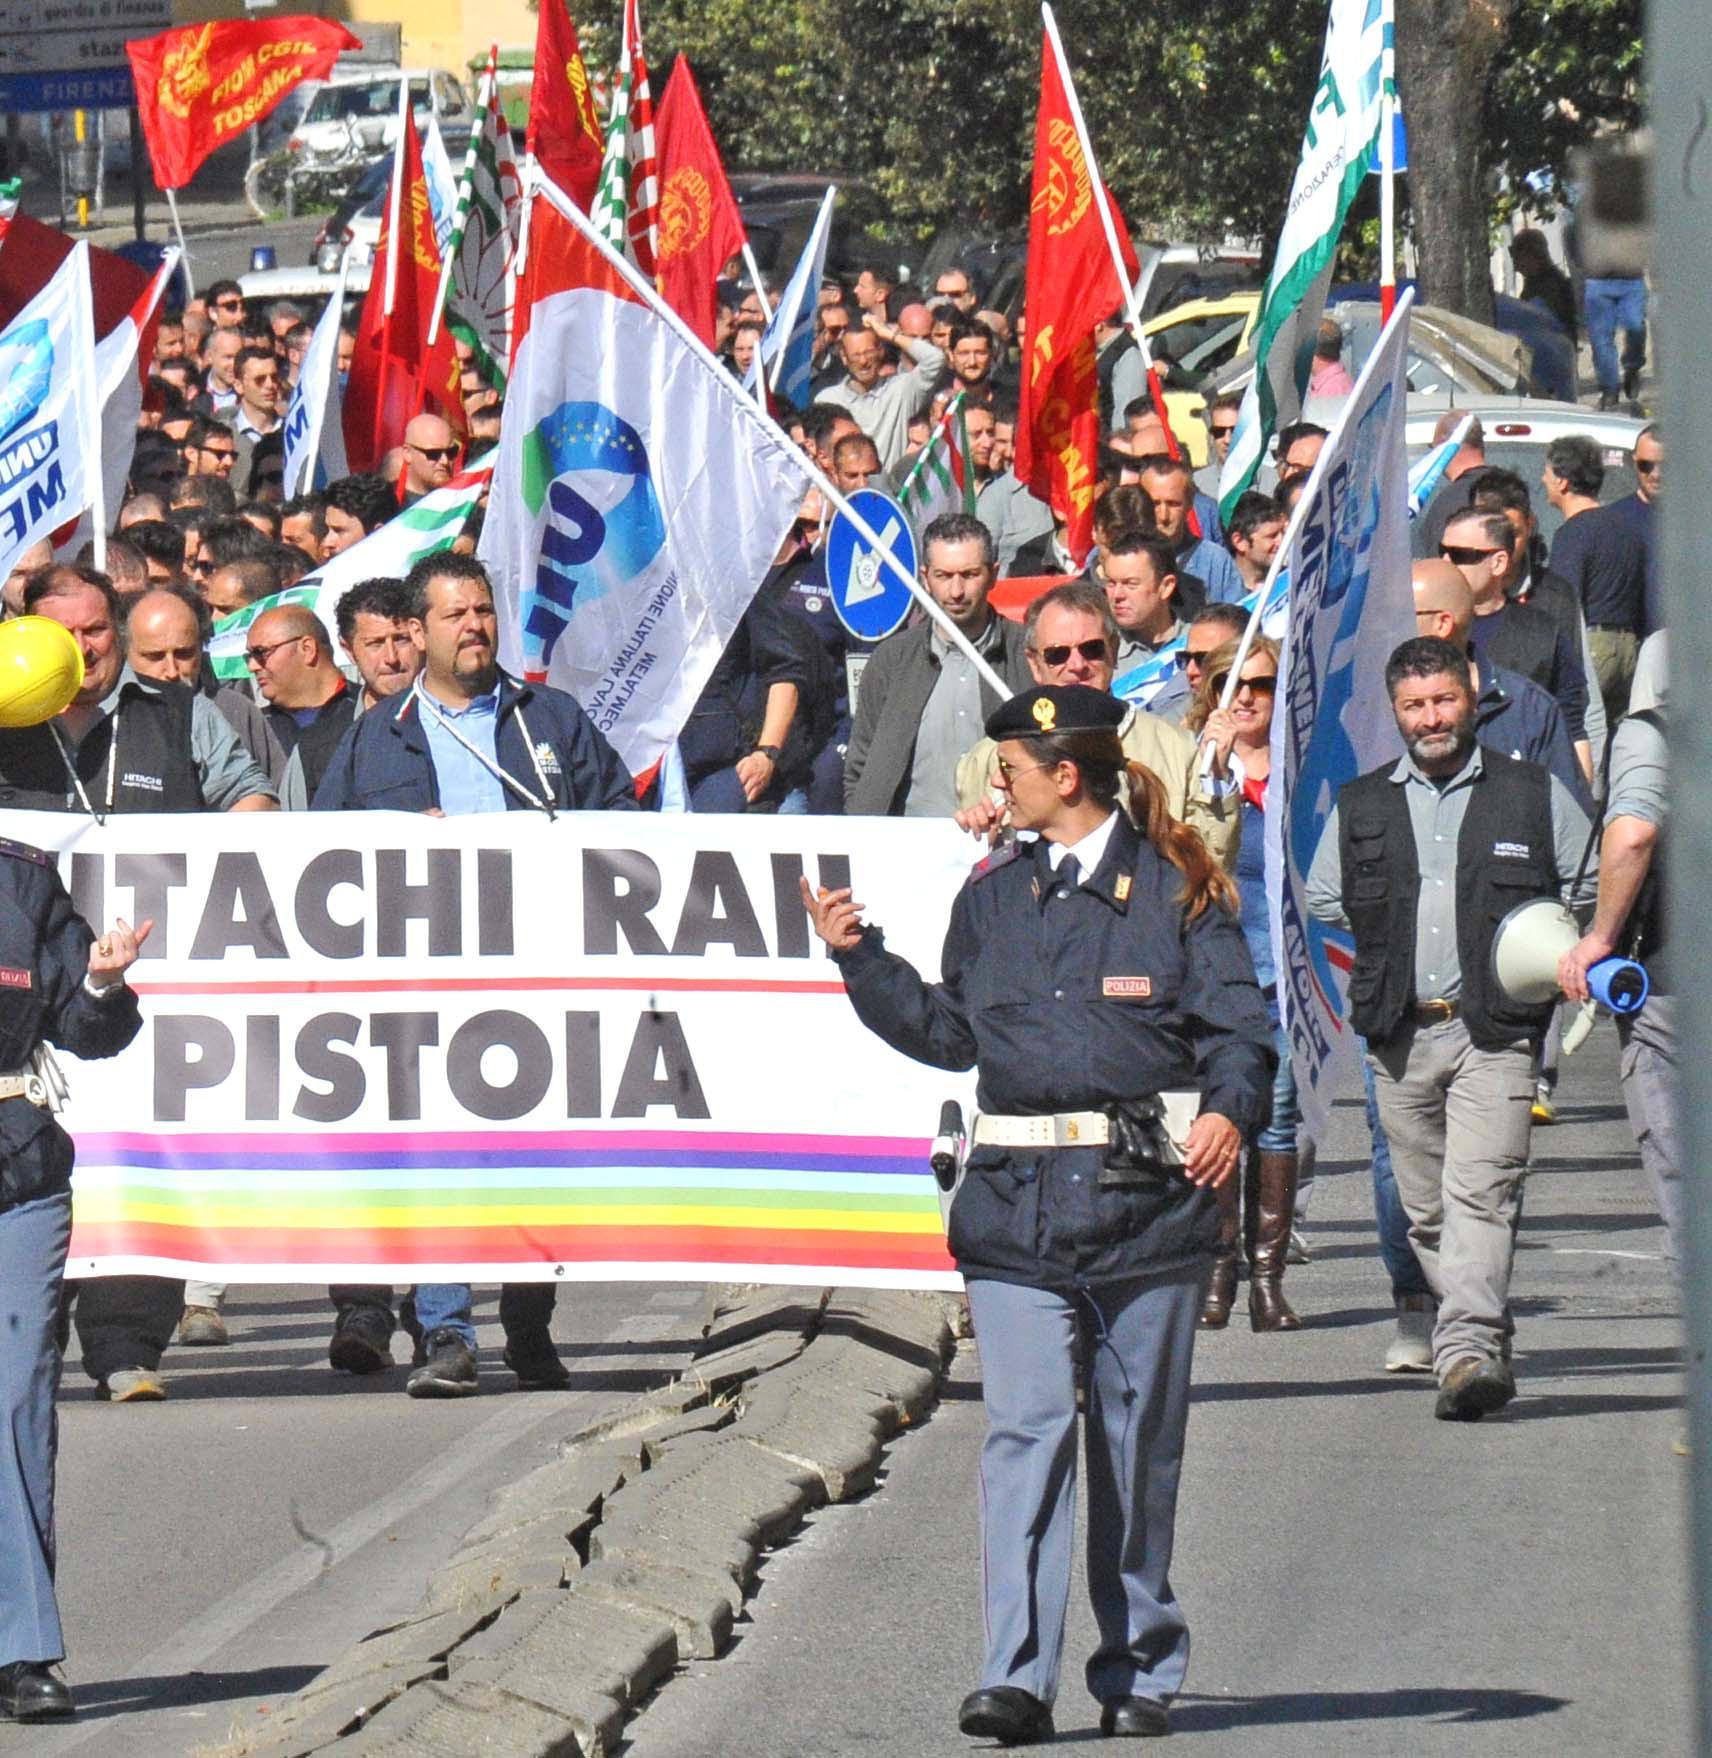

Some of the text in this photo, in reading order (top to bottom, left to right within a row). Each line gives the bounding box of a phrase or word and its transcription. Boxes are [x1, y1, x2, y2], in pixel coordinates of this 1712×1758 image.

[79, 41, 124, 57] staz
[42, 78, 130, 100] FIRENZ
[212, 53, 256, 105] FIOM
[212, 64, 303, 136] TOSCANA
[45, 848, 514, 960] ITACHI
[1105, 980, 1148, 993] POLIZIA
[154, 1008, 711, 1122] PISTOIA
